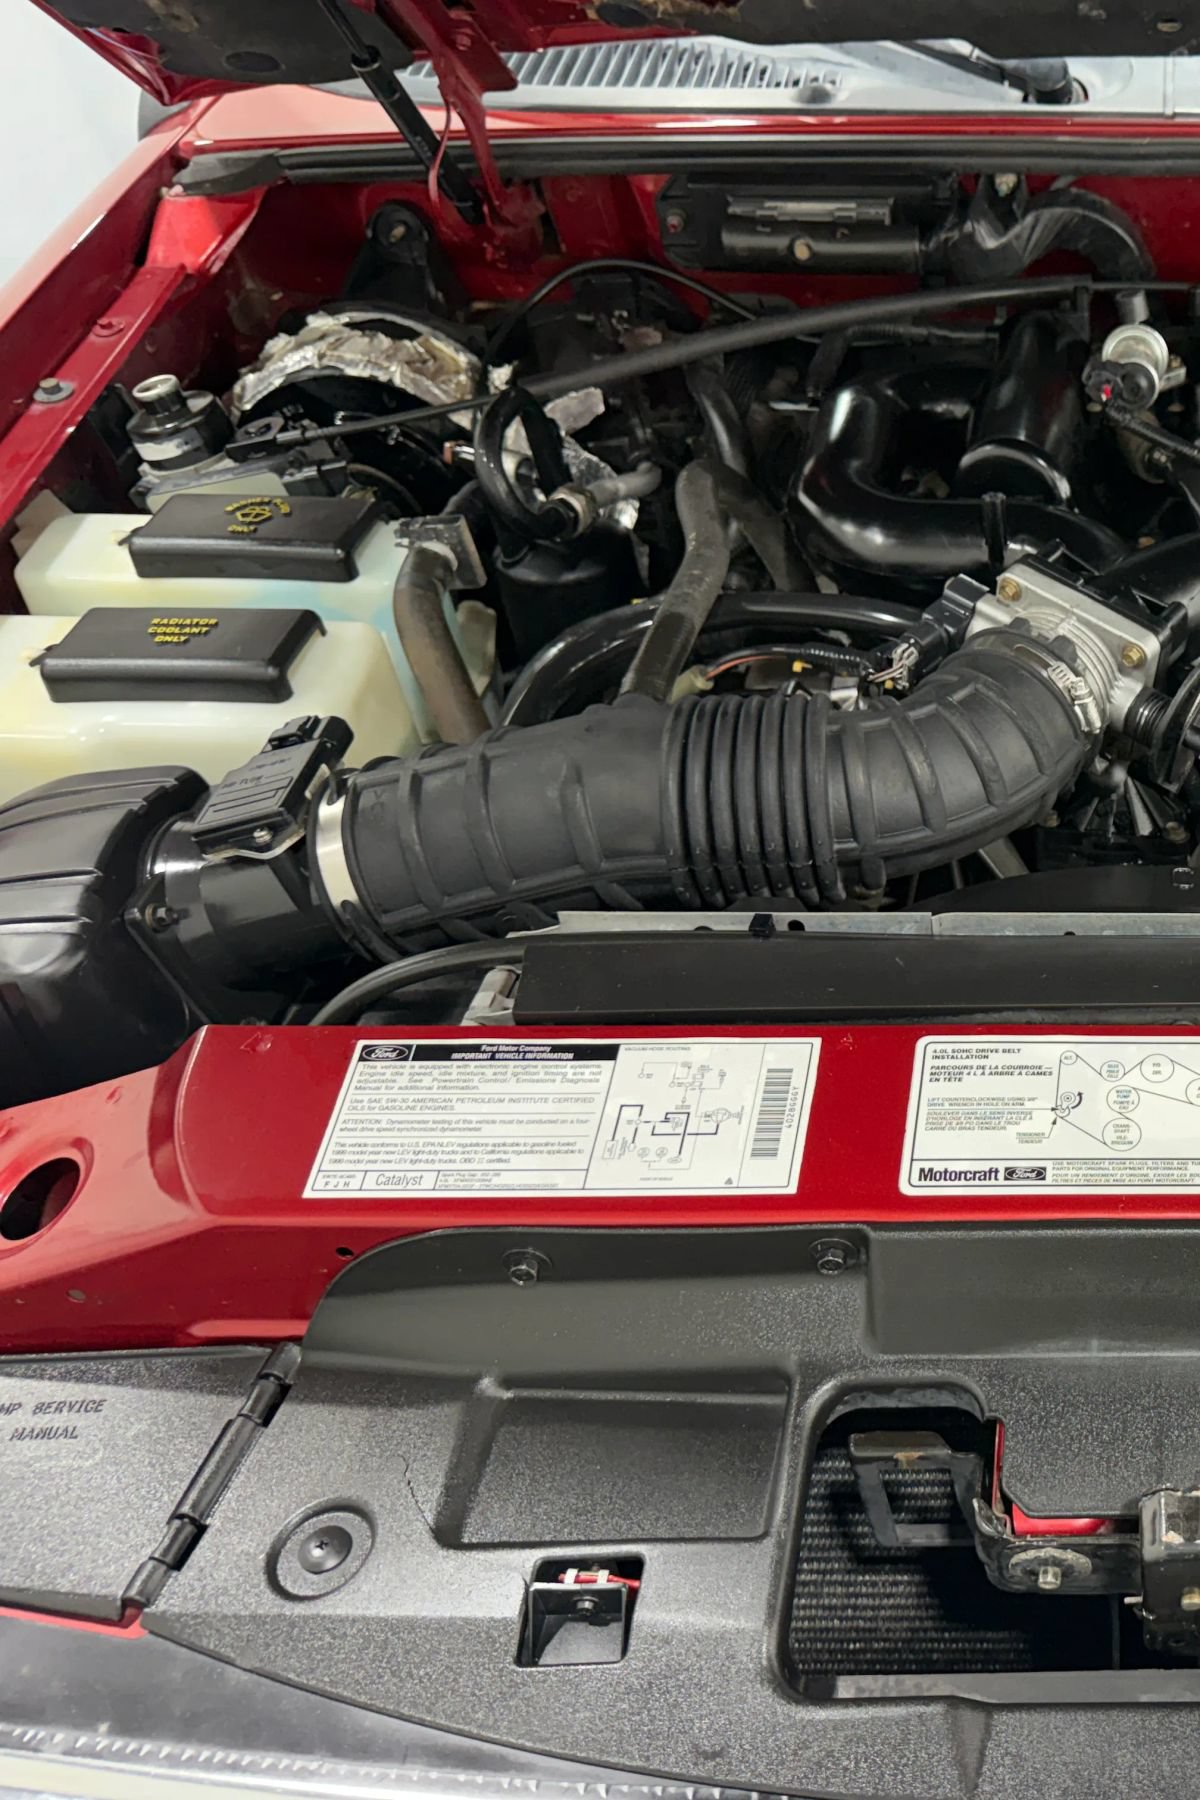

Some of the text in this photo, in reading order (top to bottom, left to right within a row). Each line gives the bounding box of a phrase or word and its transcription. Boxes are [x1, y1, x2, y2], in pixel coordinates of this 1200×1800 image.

[371, 1047, 399, 1058] Ford
[520, 1045, 551, 1053] Company
[375, 1173, 424, 1188] Catalyst
[918, 1167, 1000, 1181] Motorcraft
[9, 1426, 78, 1441] MANUAL
